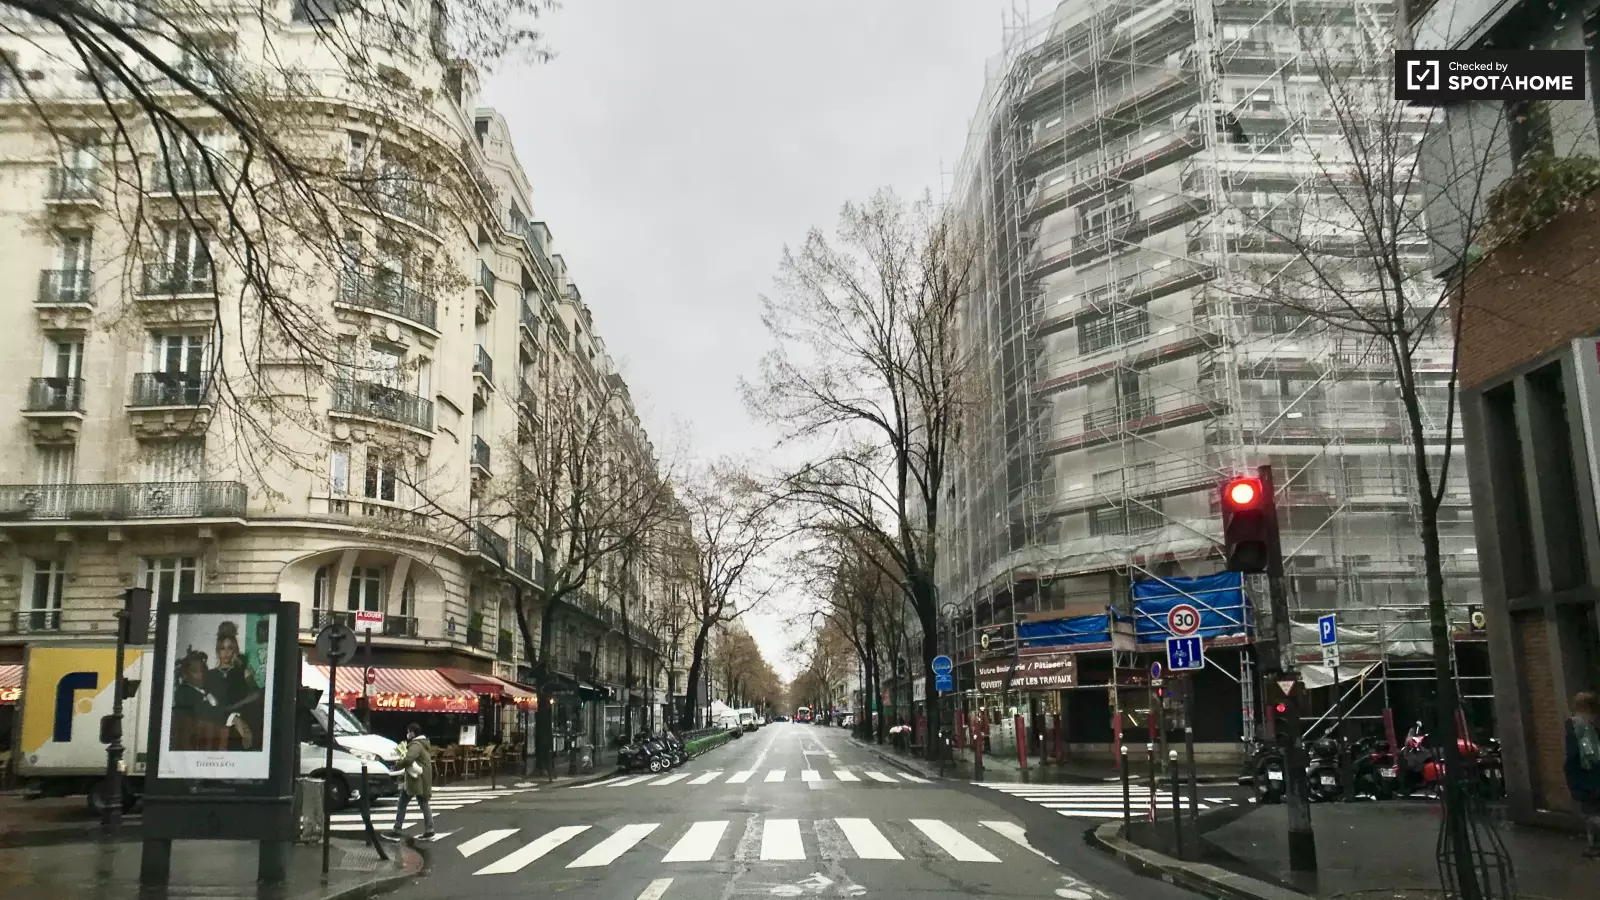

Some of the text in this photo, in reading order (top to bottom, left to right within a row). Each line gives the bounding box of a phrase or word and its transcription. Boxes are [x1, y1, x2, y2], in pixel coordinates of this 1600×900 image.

[364, 611, 382, 619] LOUER
[1174, 613, 1194, 627] 30
[1323, 621, 1331, 639] P
[1025, 676, 1038, 686] LES
[1039, 674, 1072, 685] TRAVAUX
[376, 696, 416, 708] Café Ella
